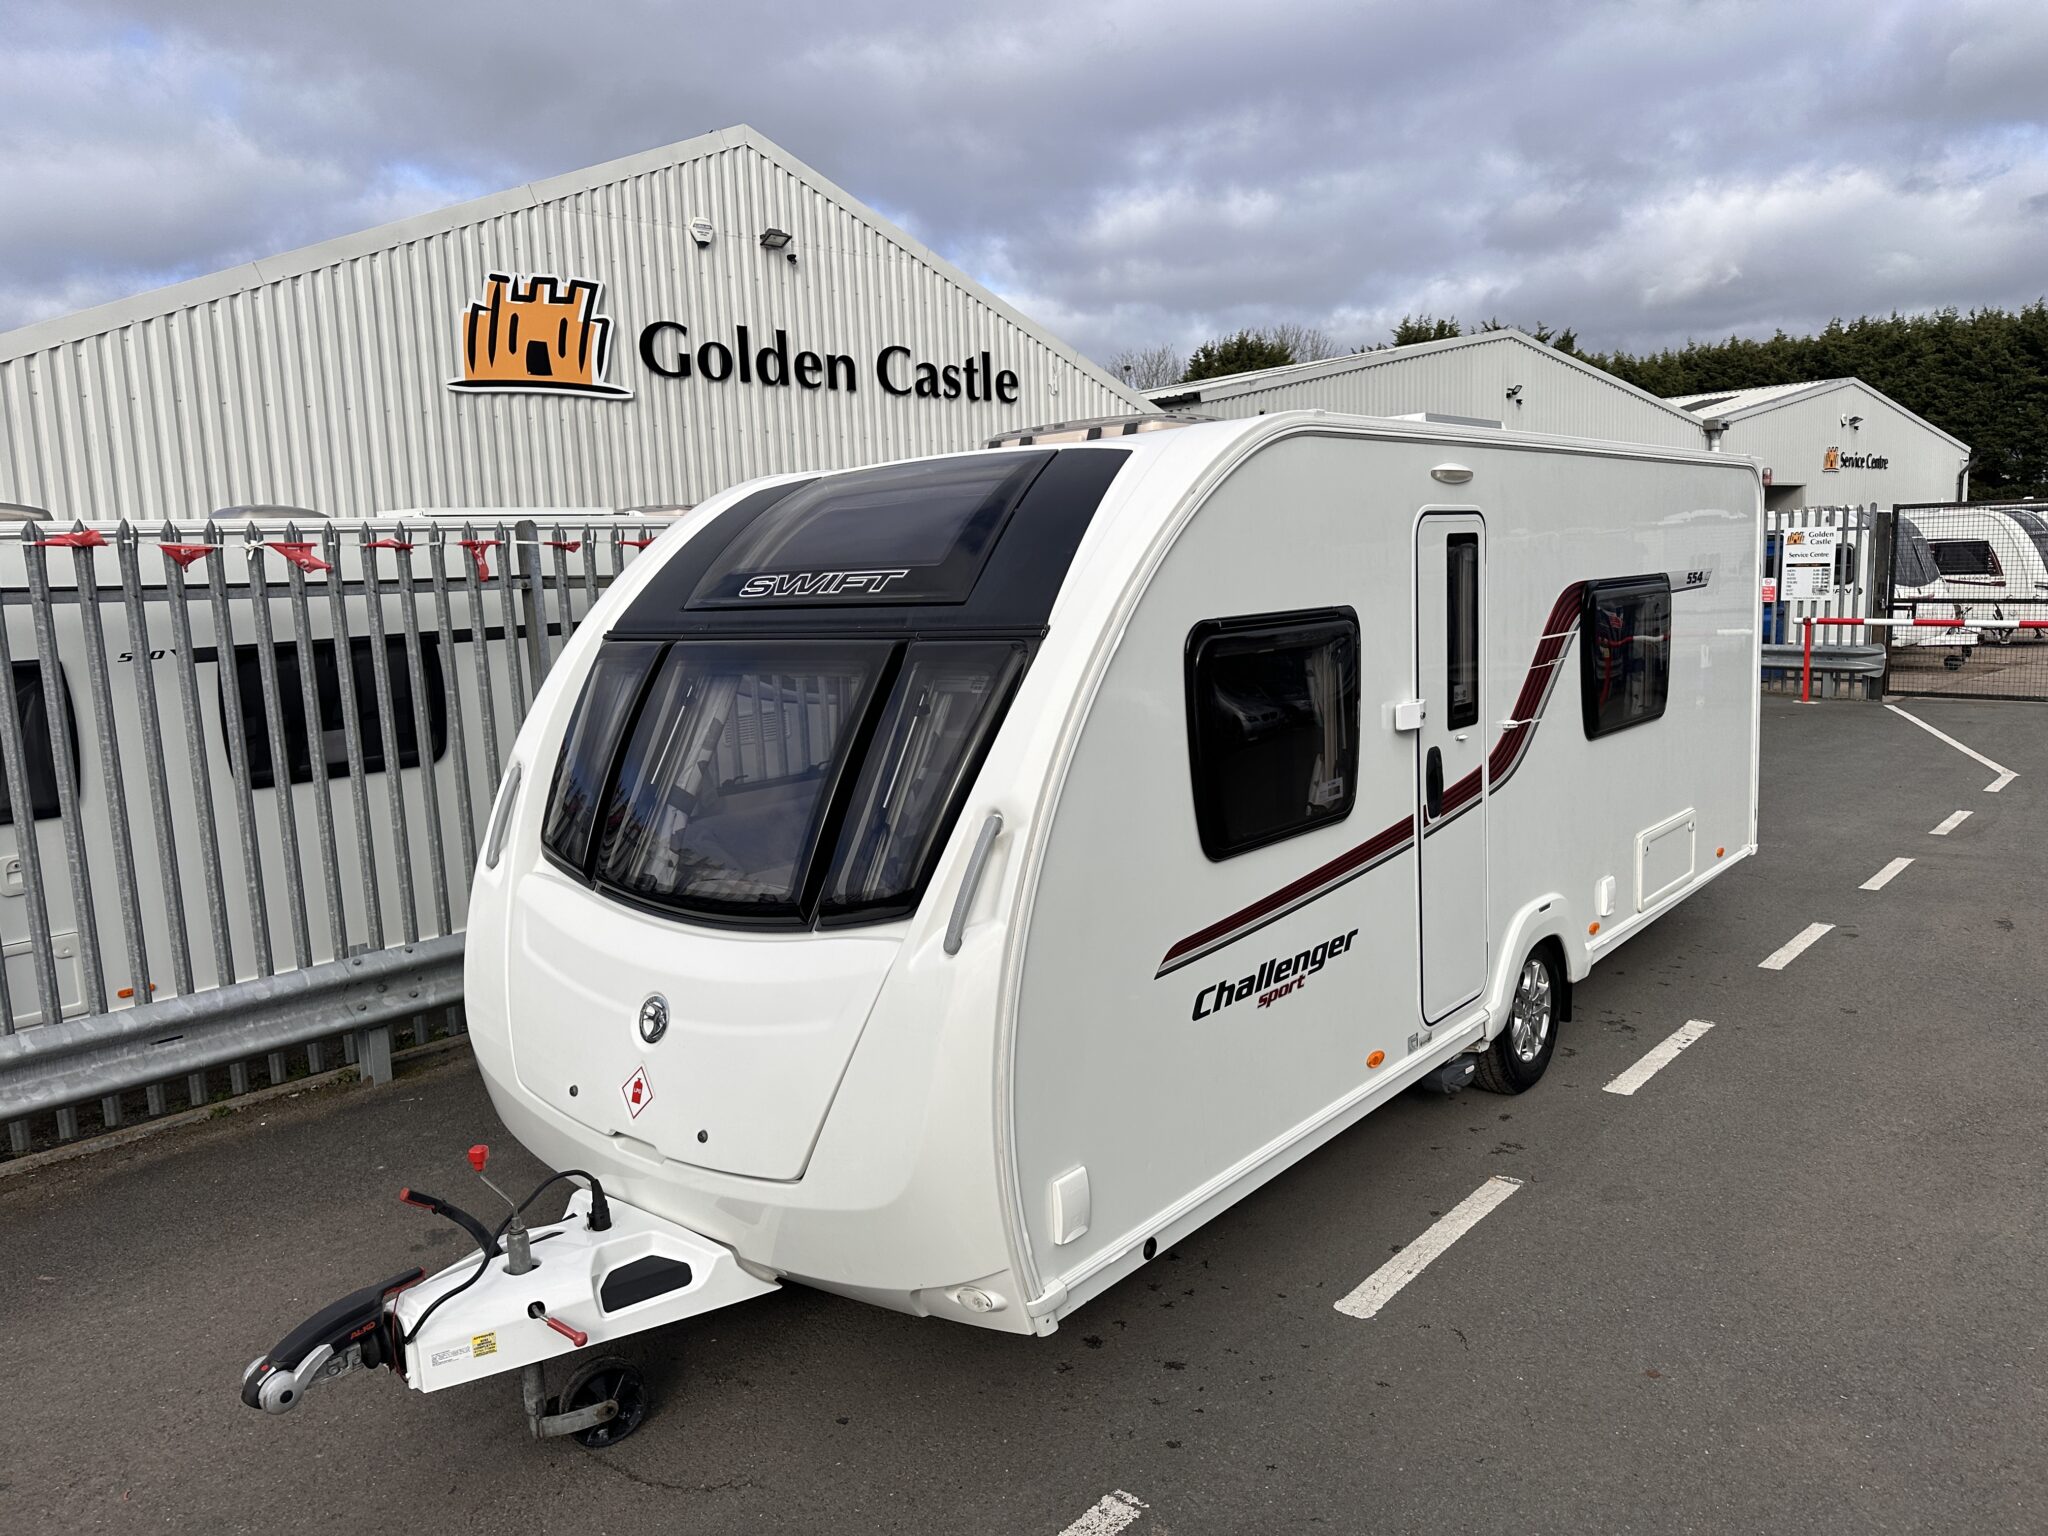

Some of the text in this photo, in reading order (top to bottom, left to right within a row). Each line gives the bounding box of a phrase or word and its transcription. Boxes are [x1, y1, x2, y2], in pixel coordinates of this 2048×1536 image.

[638, 320, 1019, 405] Golden Castle
[1840, 451, 1889, 470] Service Centre
[738, 568, 912, 598] SWIFT
[1686, 571, 1704, 584] 554
[117, 650, 166, 663] 50
[1191, 928, 1359, 1022] Challenger
[1256, 974, 1306, 1009] sport
